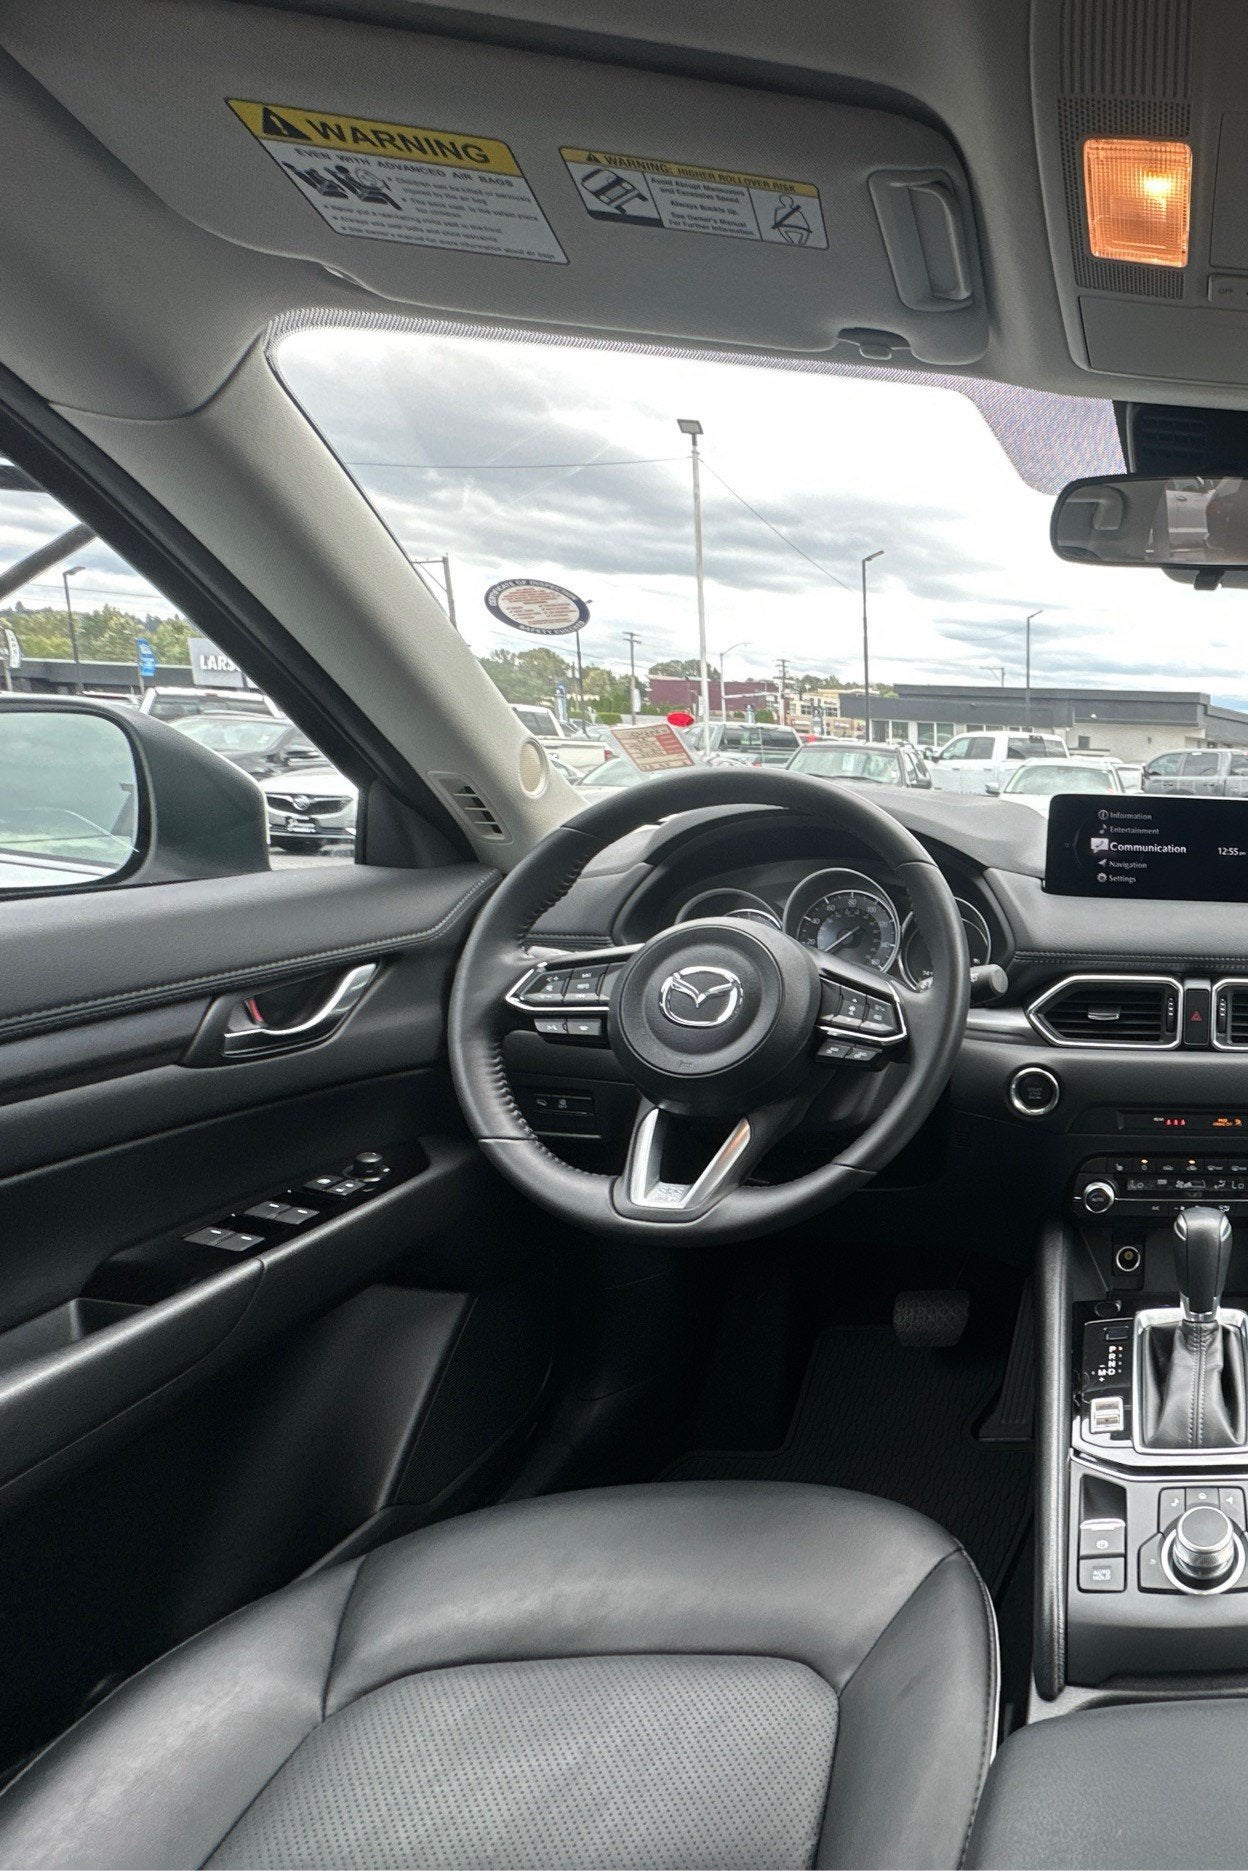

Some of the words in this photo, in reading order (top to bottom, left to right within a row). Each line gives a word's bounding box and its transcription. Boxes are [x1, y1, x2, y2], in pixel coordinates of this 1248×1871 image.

[304, 118, 492, 164] WARNING
[294, 148, 332, 160] EVEN
[335, 154, 372, 166] WITH
[374, 160, 447, 177] ADVANCED
[450, 171, 473, 180] AIR
[477, 175, 514, 186] BAGS
[677, 168, 716, 180] HIGHER
[717, 174, 770, 188] ROLLOVER
[772, 182, 796, 192] RISK
[199, 655, 241, 672] LARS
[1110, 812, 1152, 821] Information
[1109, 826, 1159, 835] Entertainment
[1110, 842, 1187, 854] Communication
[1218, 847, 1239, 857] 12:55
[1109, 860, 1148, 871] Navigation
[1108, 874, 1137, 885] Settings
[1231, 1181, 1245, 1190] Lo
